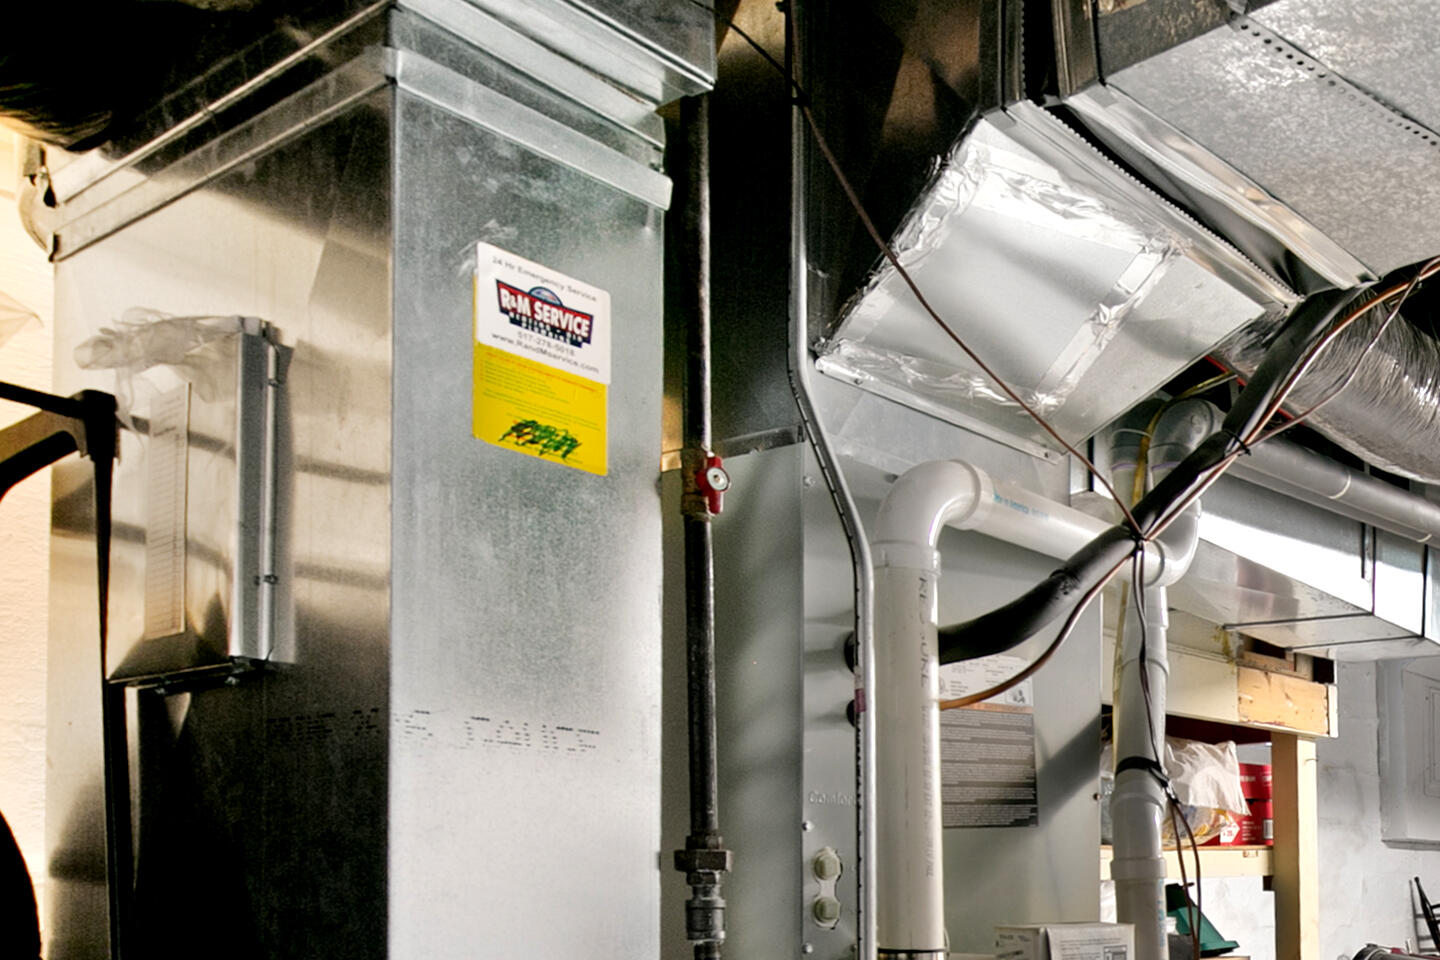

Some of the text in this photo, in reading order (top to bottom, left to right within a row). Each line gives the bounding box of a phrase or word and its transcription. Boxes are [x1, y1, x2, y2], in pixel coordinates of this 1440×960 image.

[518, 265, 565, 291] Emergency
[567, 286, 597, 302] Service
[499, 288, 532, 317] R&M
[534, 301, 590, 338] SERVICE
